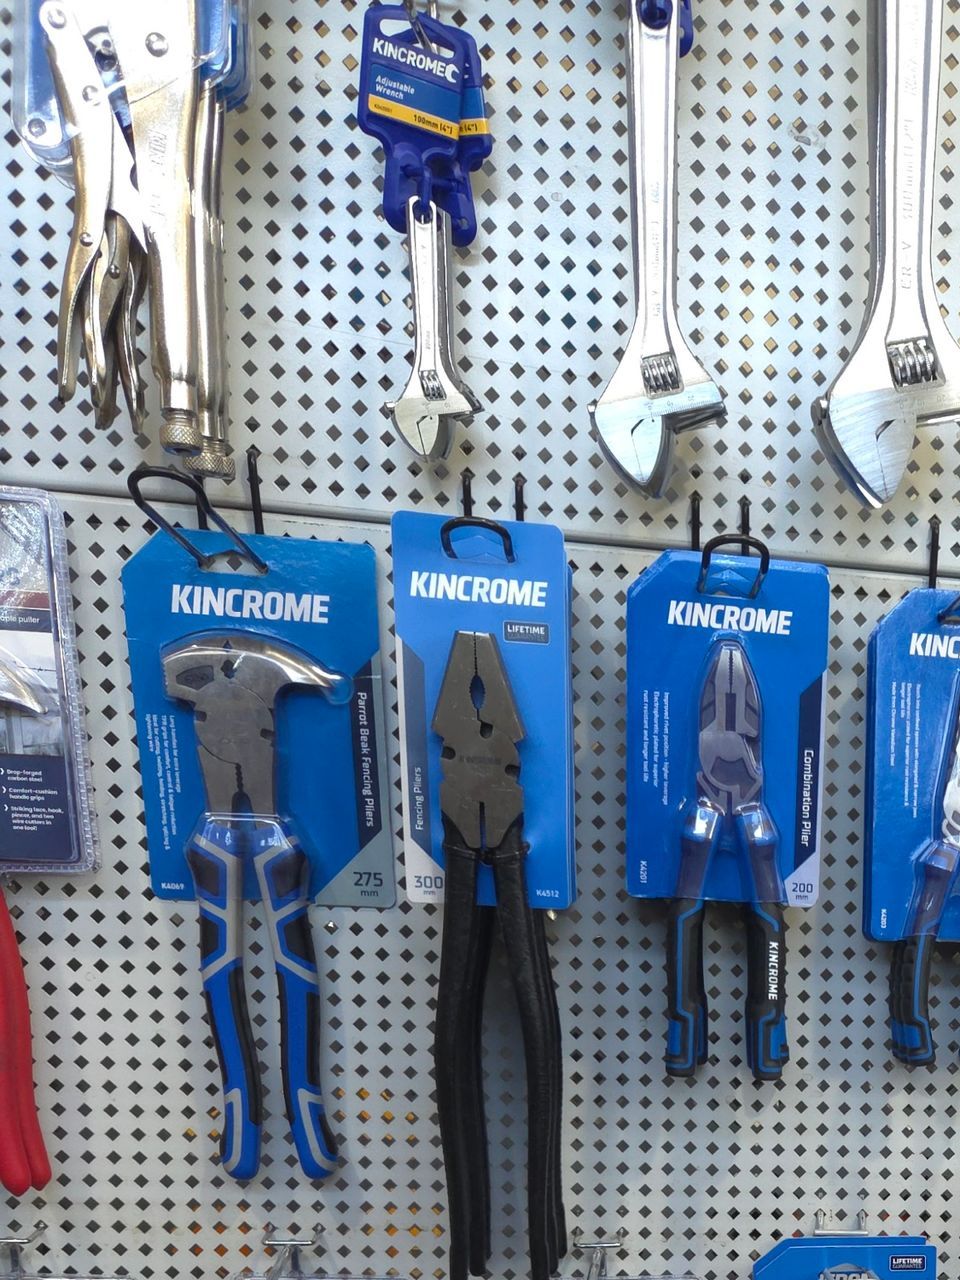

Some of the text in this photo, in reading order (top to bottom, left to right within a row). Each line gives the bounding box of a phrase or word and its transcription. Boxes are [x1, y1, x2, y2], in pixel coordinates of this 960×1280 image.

[372, 38, 446, 78] KINCROME
[376, 75, 415, 95] Adjustable
[376, 84, 404, 100] Wrench
[414, 114, 439, 130] 100mm
[409, 570, 549, 608] KINCROME
[170, 584, 331, 624] KINCROME
[667, 600, 794, 636] KINCROME
[507, 624, 545, 636] LIFETIME
[356, 692, 375, 827] Parrot Beak Fencing Pliers
[414, 766, 424, 831] Fencing Pliers
[800, 750, 814, 847] Combination Plier
[353, 872, 384, 888] 275
[414, 874, 444, 889] 300
[791, 882, 814, 893] 200
[536, 889, 560, 898] K4512
[767, 941, 780, 1001] KINCROME
[892, 1257, 922, 1265] LIFETIME
